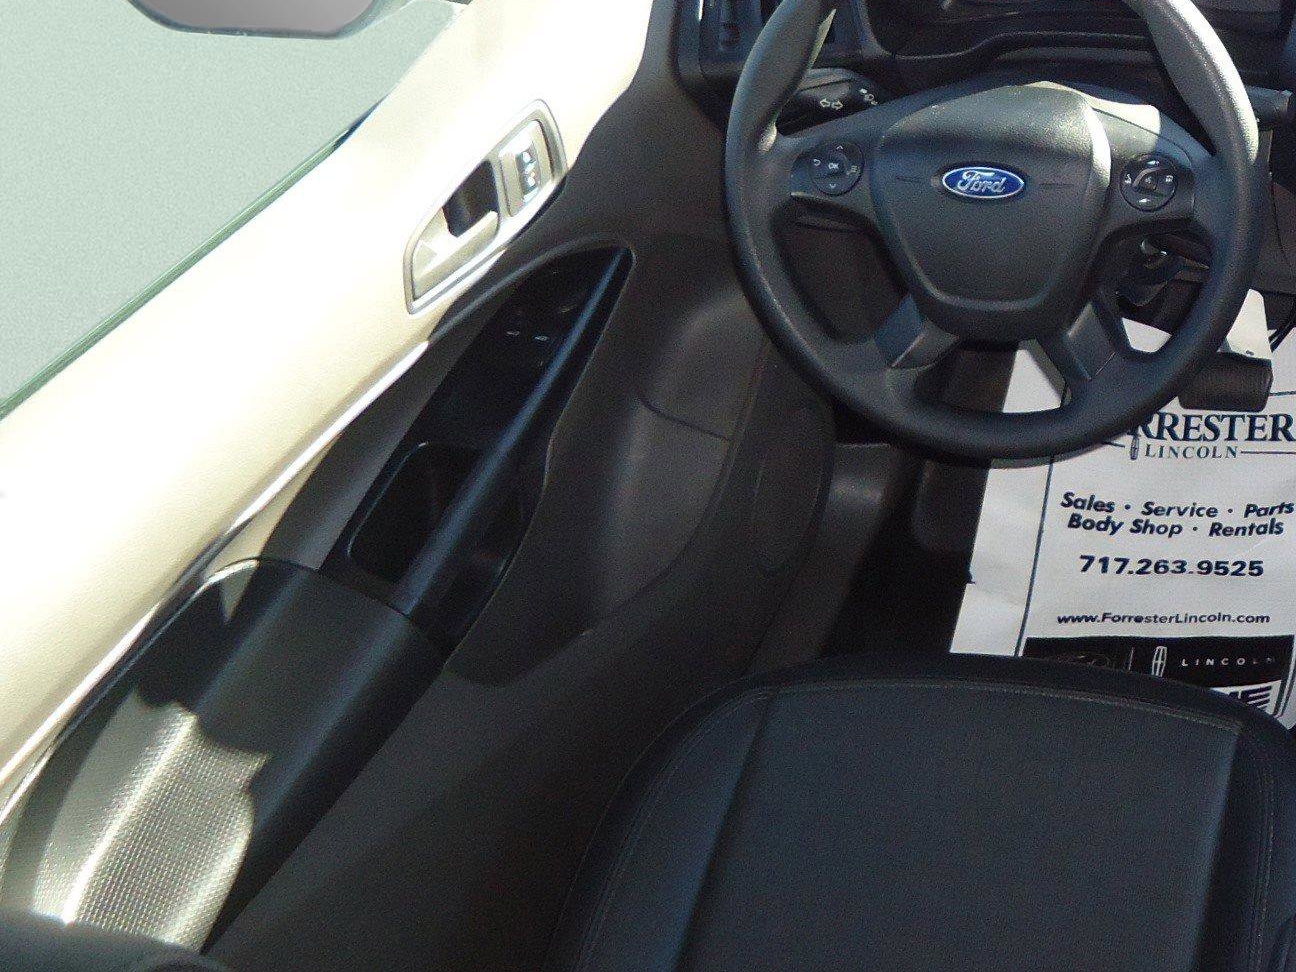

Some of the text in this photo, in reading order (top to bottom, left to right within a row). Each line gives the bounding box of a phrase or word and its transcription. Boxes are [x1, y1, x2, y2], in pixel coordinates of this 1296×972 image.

[957, 170, 1007, 193] Ford
[1145, 443, 1239, 460] LINCOLN
[1060, 491, 1295, 518] Sales Service Parts
[1067, 513, 1284, 538] Body Shop Rentals
[1080, 554, 1264, 577] 717.263.9525
[1057, 612, 1271, 625] www.ForresterLincoln.com
